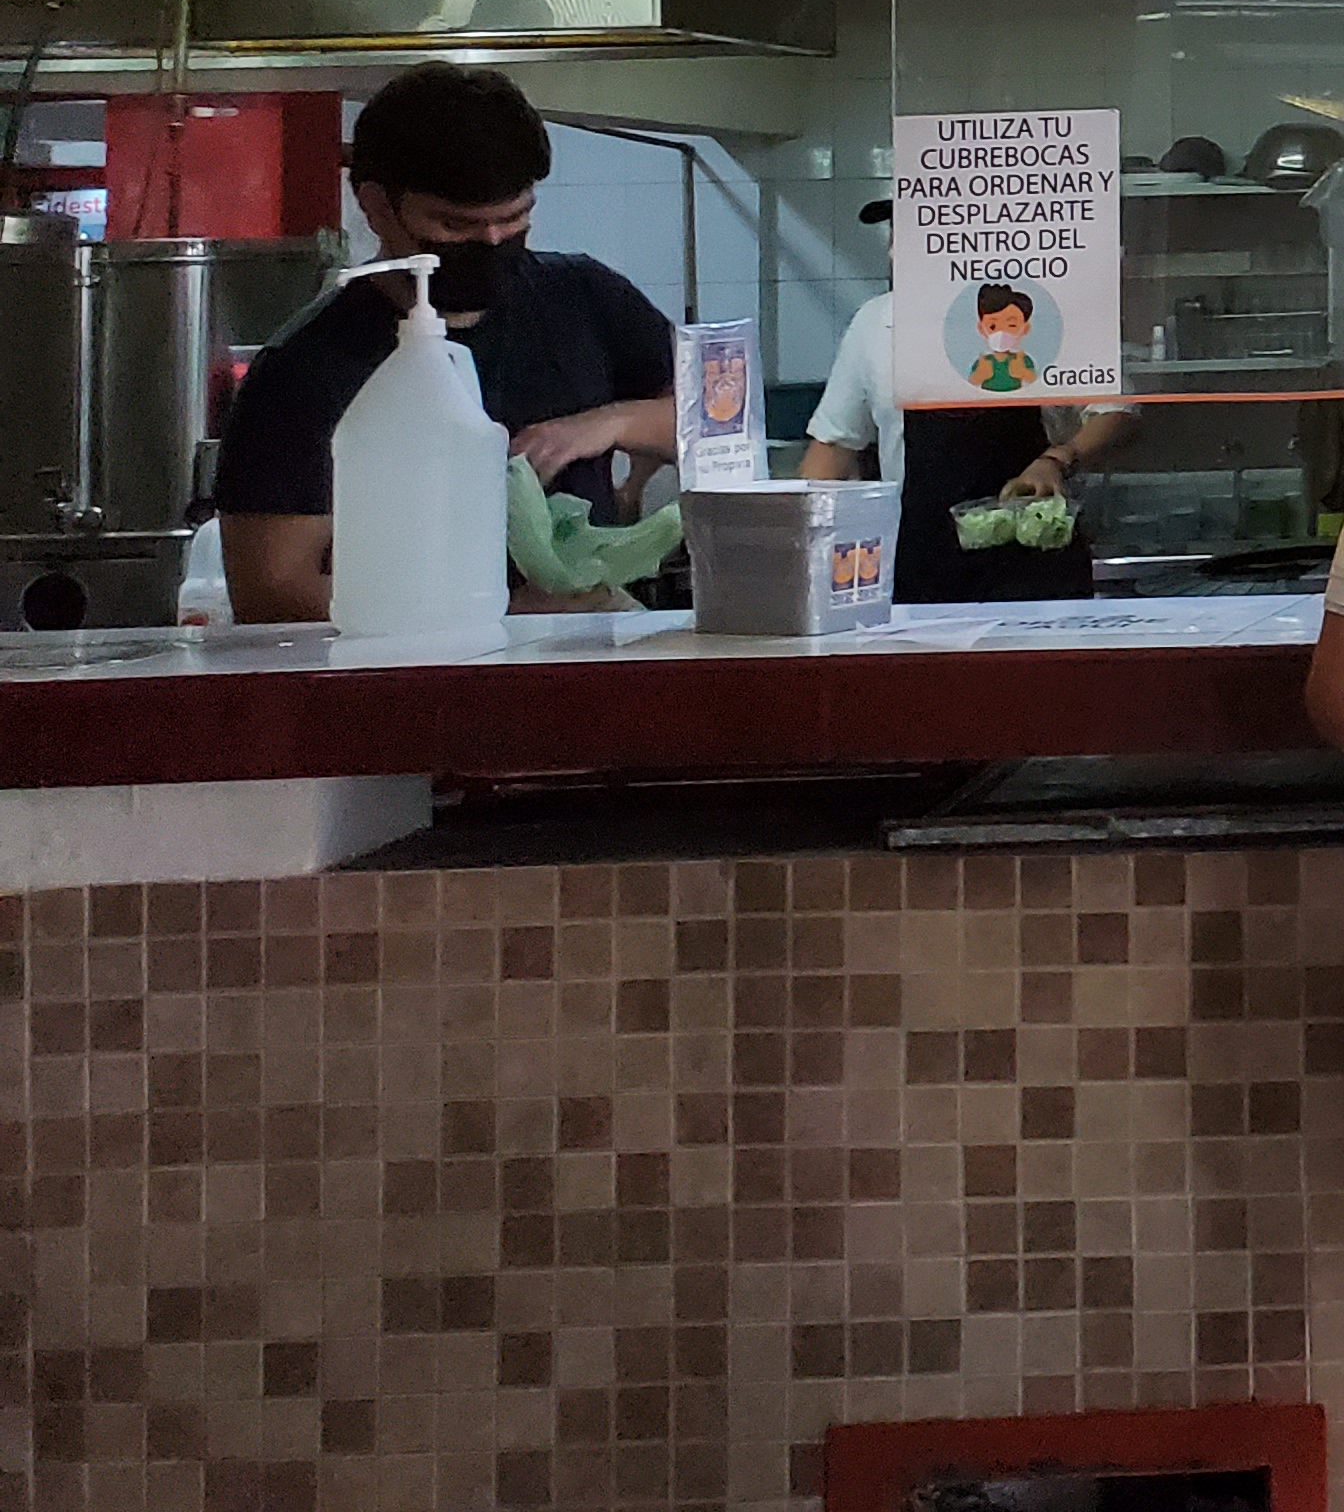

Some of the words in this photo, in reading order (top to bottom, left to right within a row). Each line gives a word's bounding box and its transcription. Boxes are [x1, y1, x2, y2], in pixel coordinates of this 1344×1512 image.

[939, 118, 1033, 141] UTILIZA
[1038, 116, 1071, 138] TU
[921, 144, 1089, 169] CUBREBOCAS
[898, 177, 961, 199] PARA
[969, 172, 1093, 196] ORDENAR
[1098, 171, 1113, 191] Y
[918, 200, 1094, 226] DESPLAZARTE
[927, 230, 1030, 254] DENTRO
[1039, 228, 1085, 250] DEL
[951, 257, 1067, 281] NEGOCIO
[1043, 364, 1115, 385] Gracias
